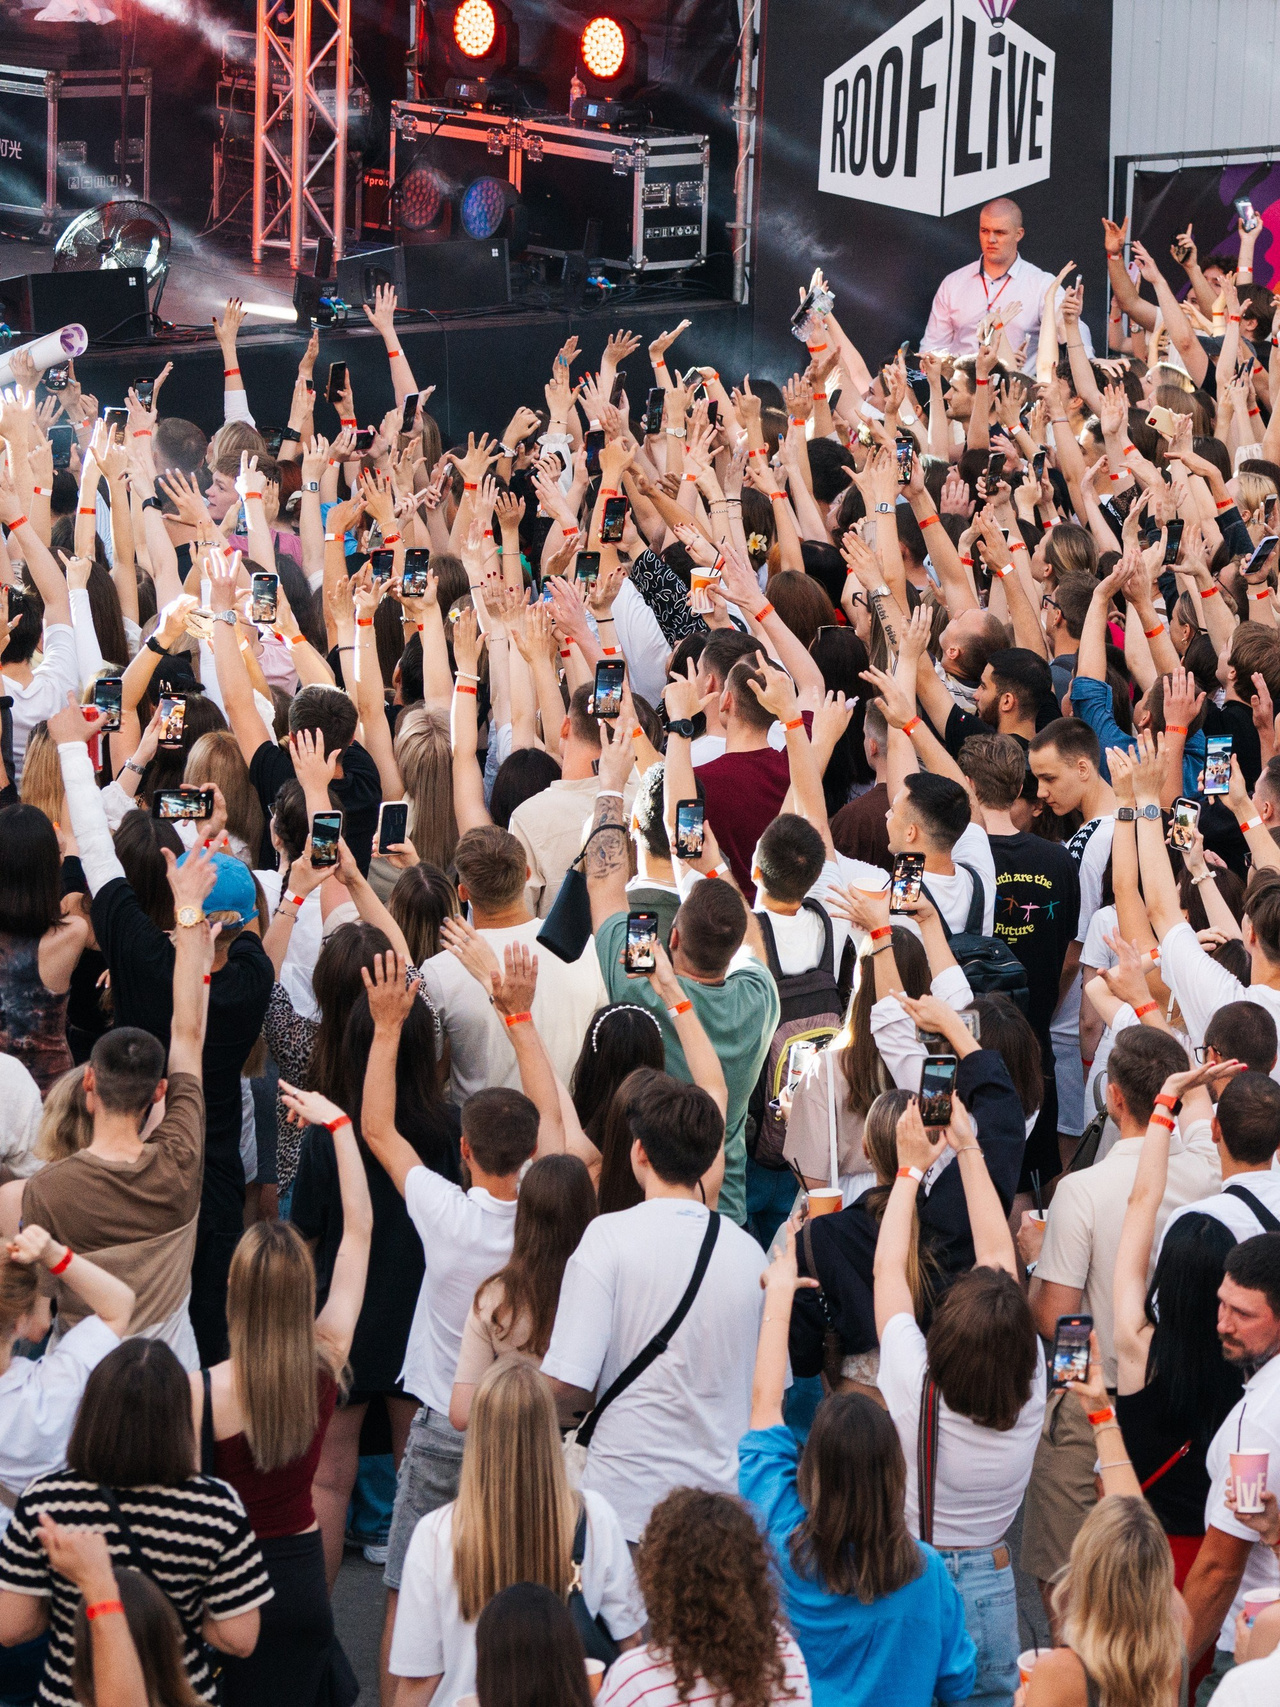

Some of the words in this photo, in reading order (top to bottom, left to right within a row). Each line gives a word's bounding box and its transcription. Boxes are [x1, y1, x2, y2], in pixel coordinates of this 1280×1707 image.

[830, 15, 943, 178] ROOF
[1013, 873, 1033, 882] are
[1034, 874, 1053, 889] the
[994, 922, 1035, 936] Future
